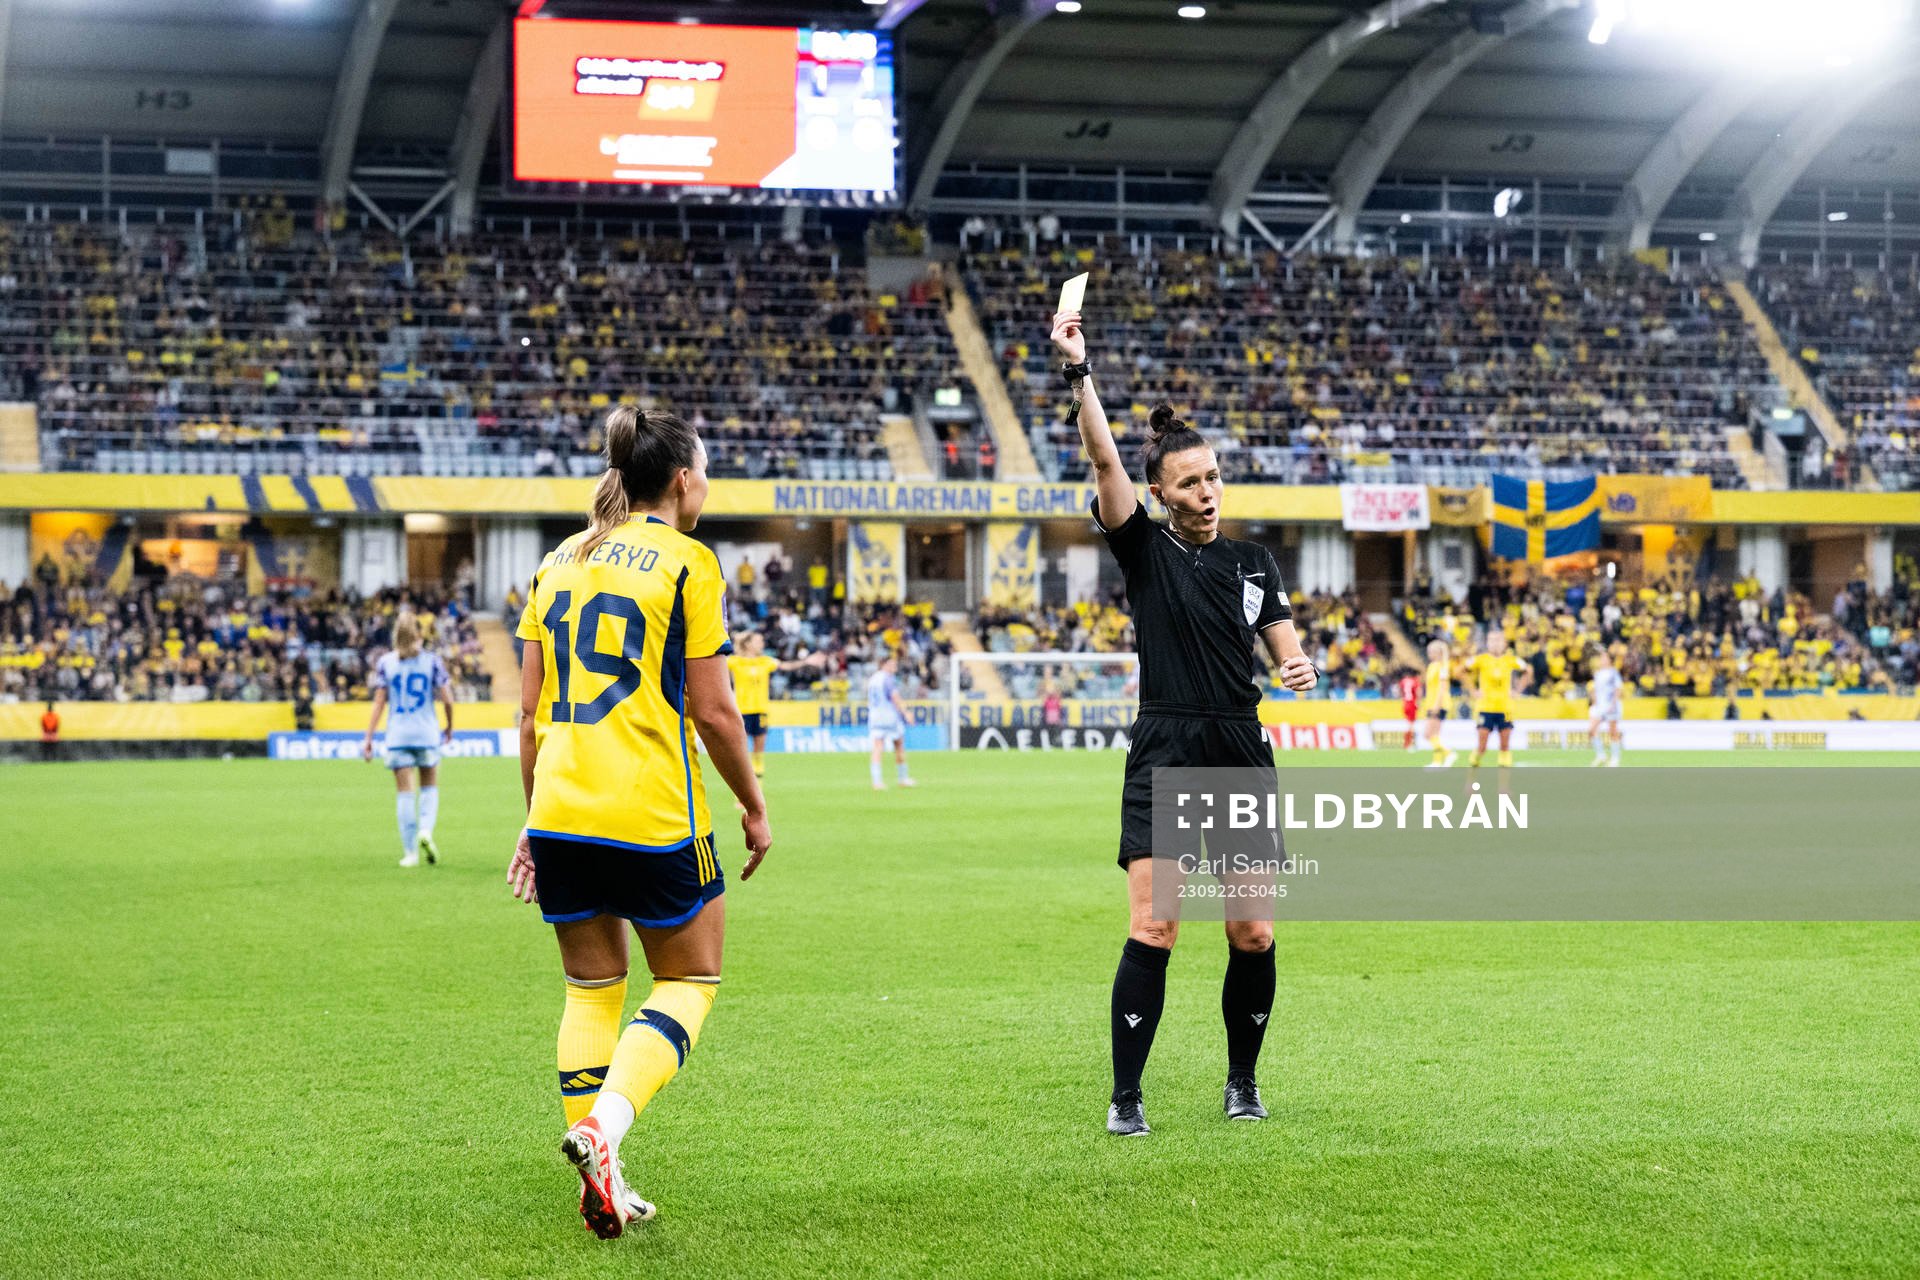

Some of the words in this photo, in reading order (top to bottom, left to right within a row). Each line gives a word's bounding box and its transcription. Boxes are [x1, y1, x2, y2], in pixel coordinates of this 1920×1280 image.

[1065, 120, 1111, 138] J4
[774, 485, 992, 512] NATIONALARENAN
[554, 541, 659, 572] KERYD
[543, 590, 646, 725] 19
[391, 673, 429, 714] 19
